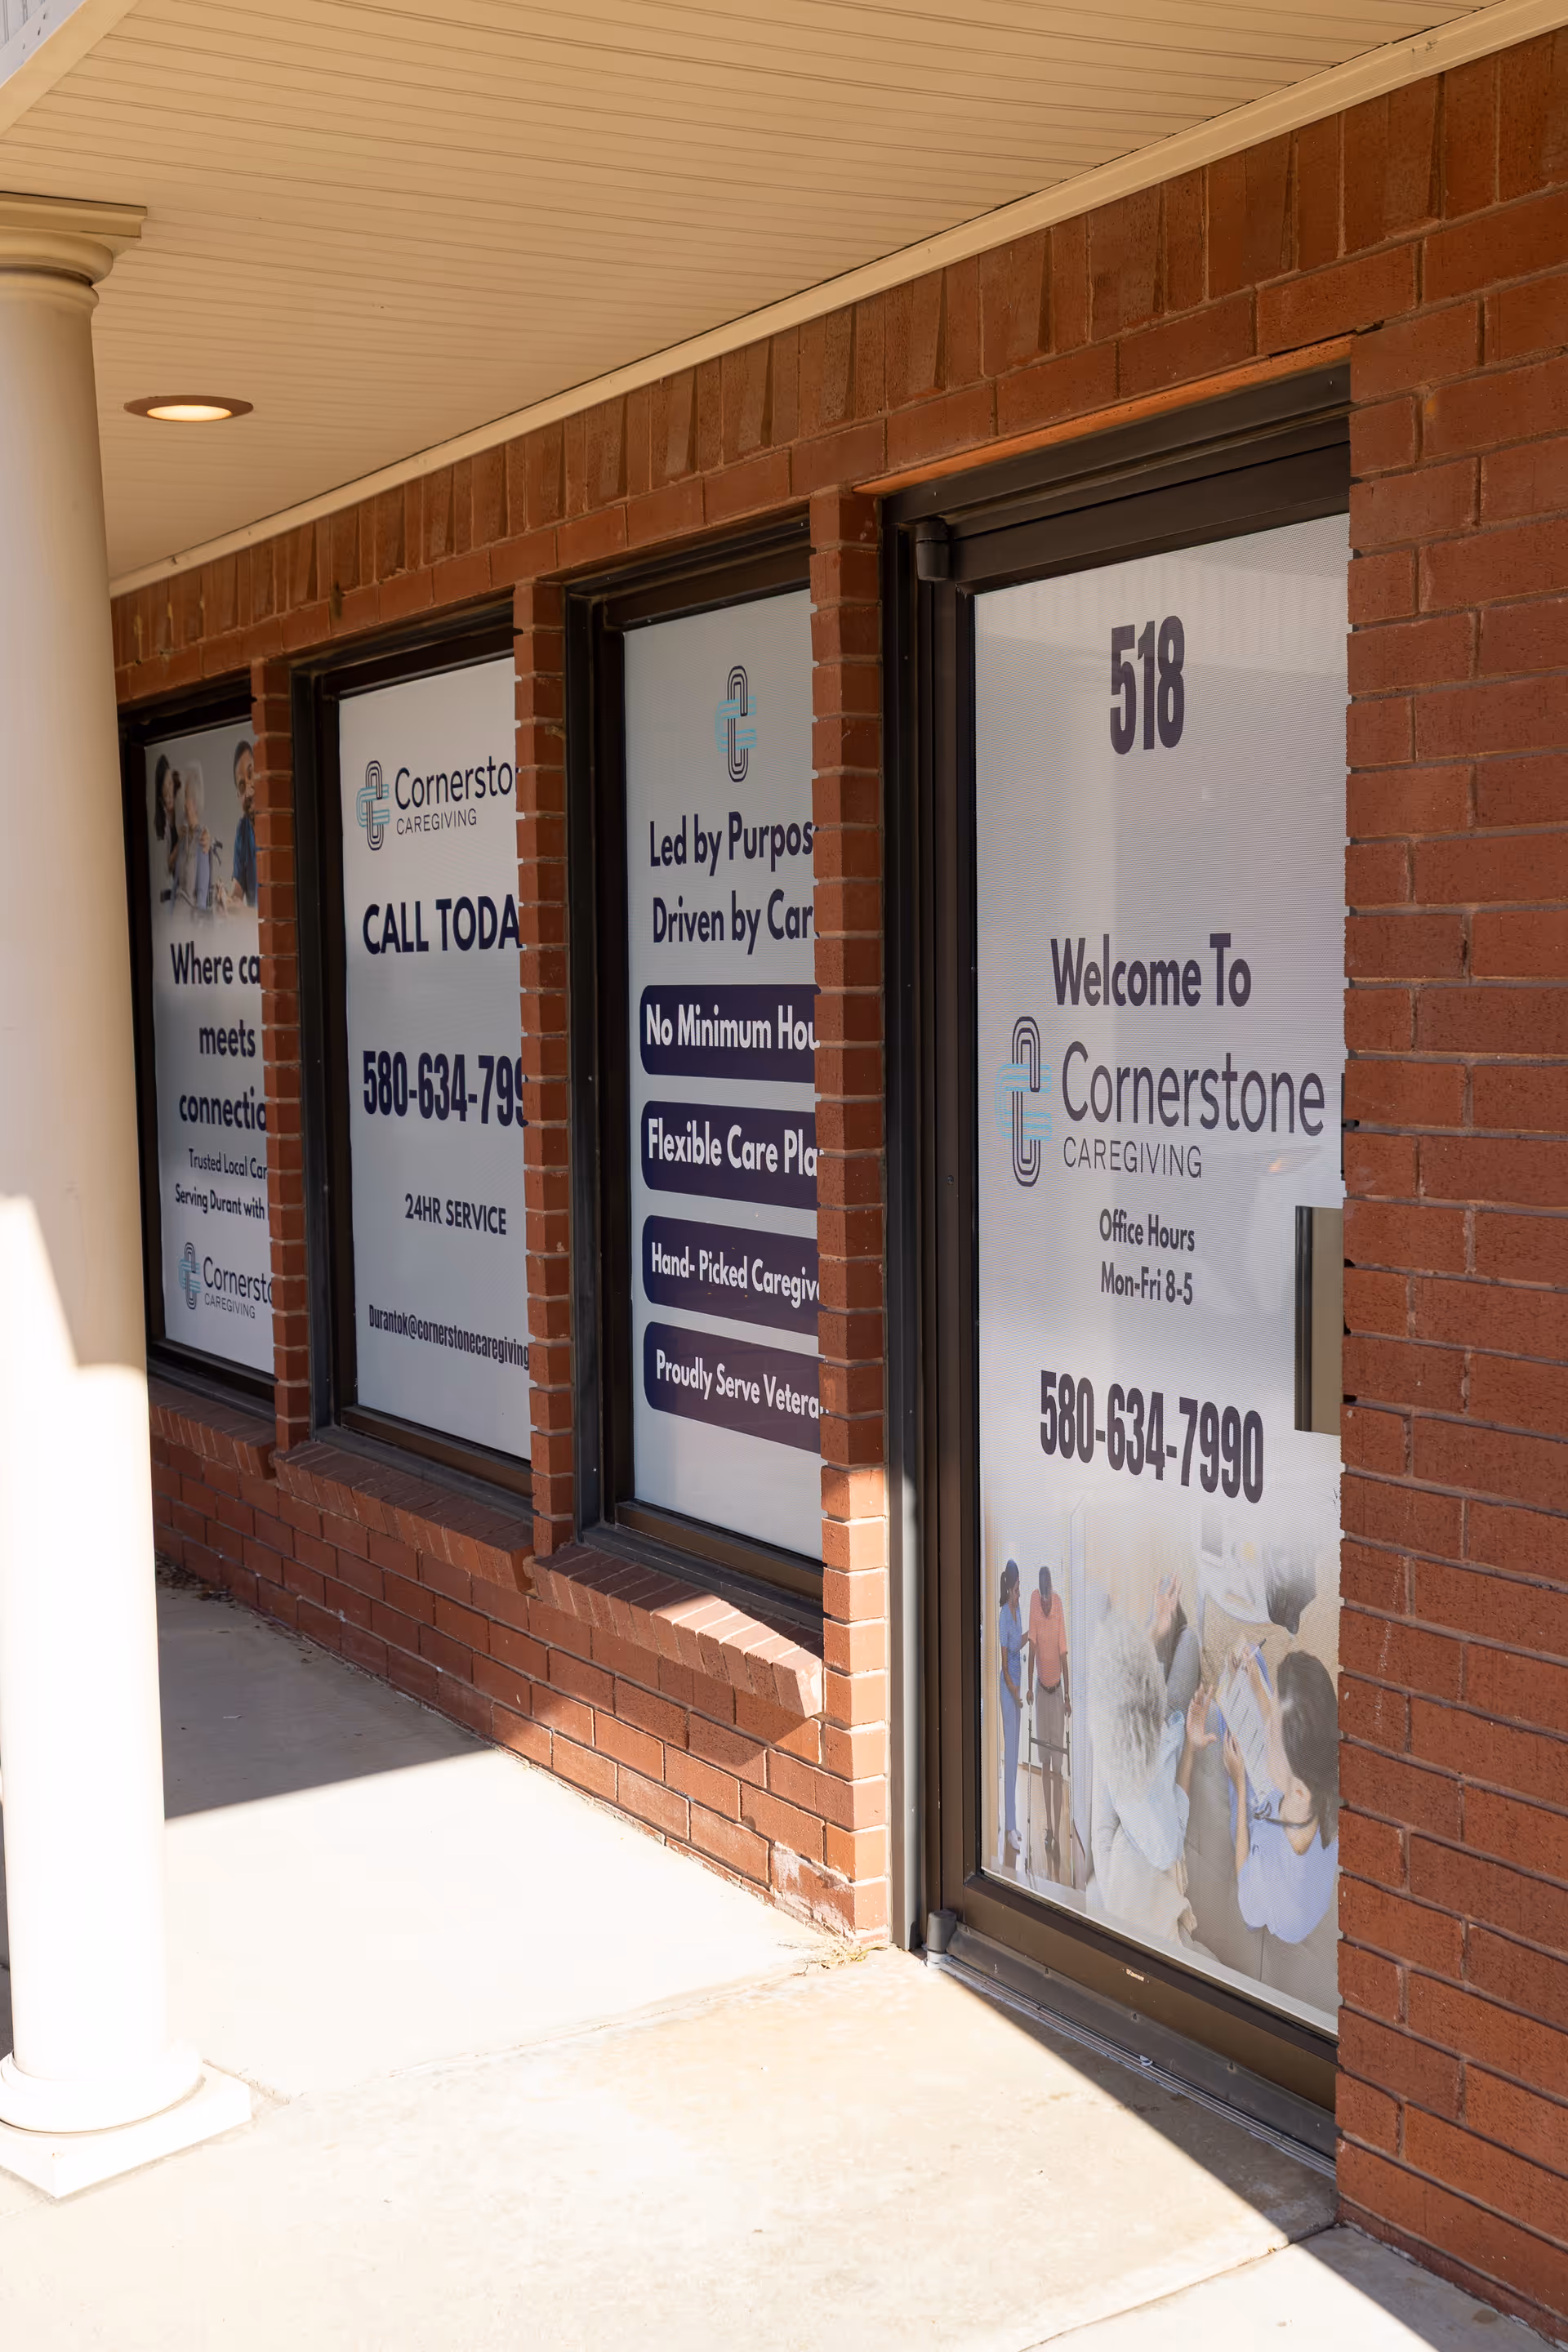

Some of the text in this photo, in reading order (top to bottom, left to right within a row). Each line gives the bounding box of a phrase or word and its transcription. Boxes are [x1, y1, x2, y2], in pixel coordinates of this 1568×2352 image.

[1110, 615, 1185, 755] 518
[394, 755, 519, 811] Cornersto
[396, 808, 477, 835] CAREGIVING
[649, 811, 819, 876] Led by Purpos
[363, 894, 523, 955] CALL TODA
[653, 889, 820, 955] Driven by Car
[170, 940, 261, 985] Where ca
[1050, 933, 1251, 1007] Welcome To
[199, 1019, 256, 1058] meets
[646, 1004, 673, 1046] No
[678, 1004, 772, 1049] Minimum
[178, 1085, 266, 1131] connectio
[1062, 1040, 1325, 1136] Cornerstone
[189, 1148, 221, 1173] Trusted
[224, 1153, 247, 1177] Local
[648, 1117, 824, 1177] Flexible Care Pla
[1063, 1136, 1202, 1178] CAREGIVING
[175, 1183, 207, 1214] Serving
[210, 1190, 242, 1215] Durant
[243, 1197, 265, 1220] with
[405, 1193, 506, 1236] 24HR SERVICE
[1099, 1209, 1195, 1251] Office Hours
[652, 1241, 820, 1308] Hand- Picked Caregiv
[1101, 1261, 1193, 1306] Mon-Fri 8-5
[204, 1293, 255, 1319] CAREGIVING
[369, 1305, 529, 1371] Durantok@cornerstonecaregiving
[657, 1349, 712, 1400] Proudly
[716, 1363, 760, 1404] Serve
[1040, 1370, 1264, 1503] 580-634-7990
